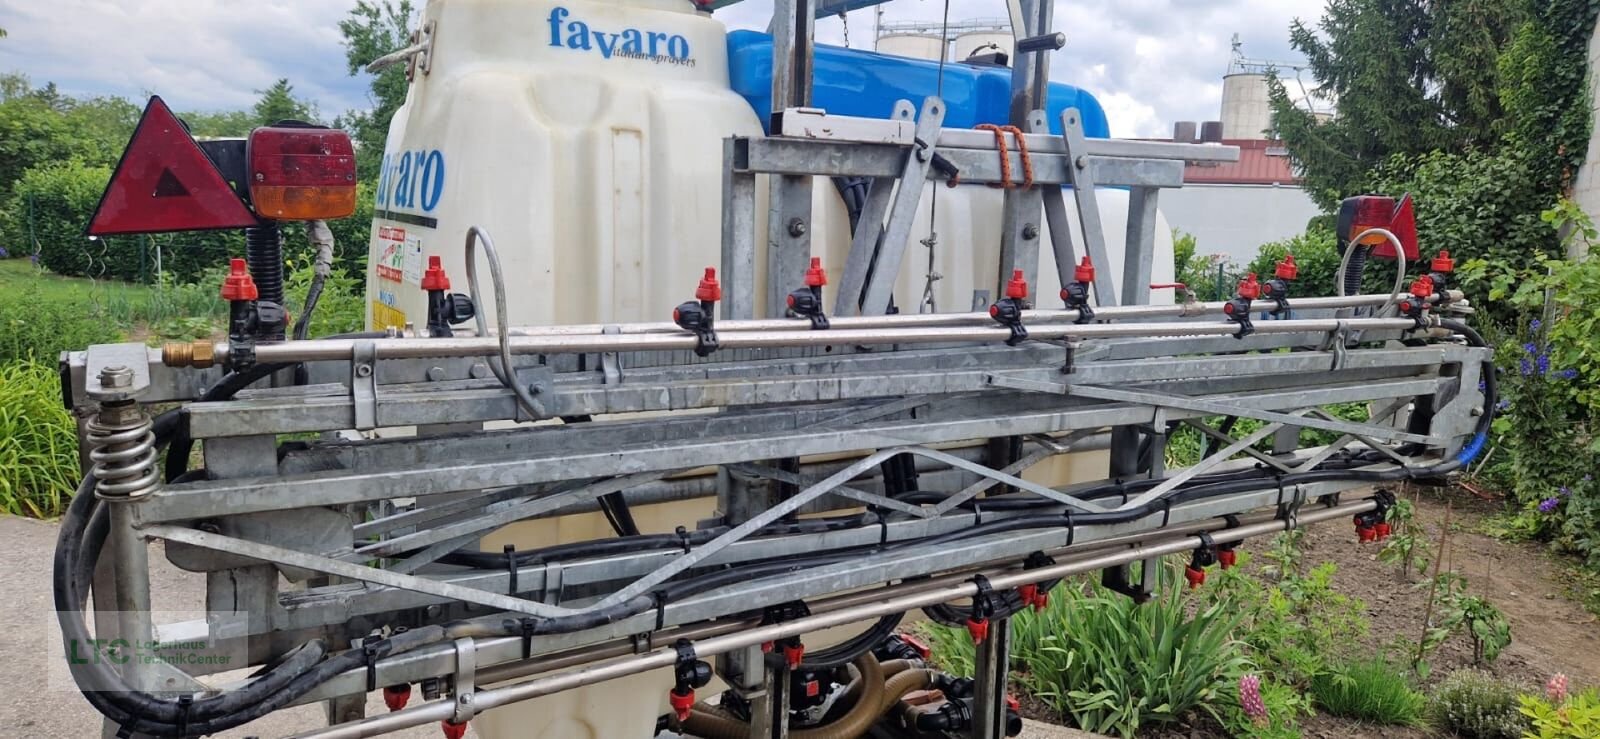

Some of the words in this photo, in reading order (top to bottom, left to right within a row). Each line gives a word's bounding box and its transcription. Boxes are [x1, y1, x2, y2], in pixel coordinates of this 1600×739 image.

[547, 6, 690, 59] favaro
[612, 46, 652, 60] italian
[653, 52, 697, 68] sprayers
[377, 149, 445, 212] avaro
